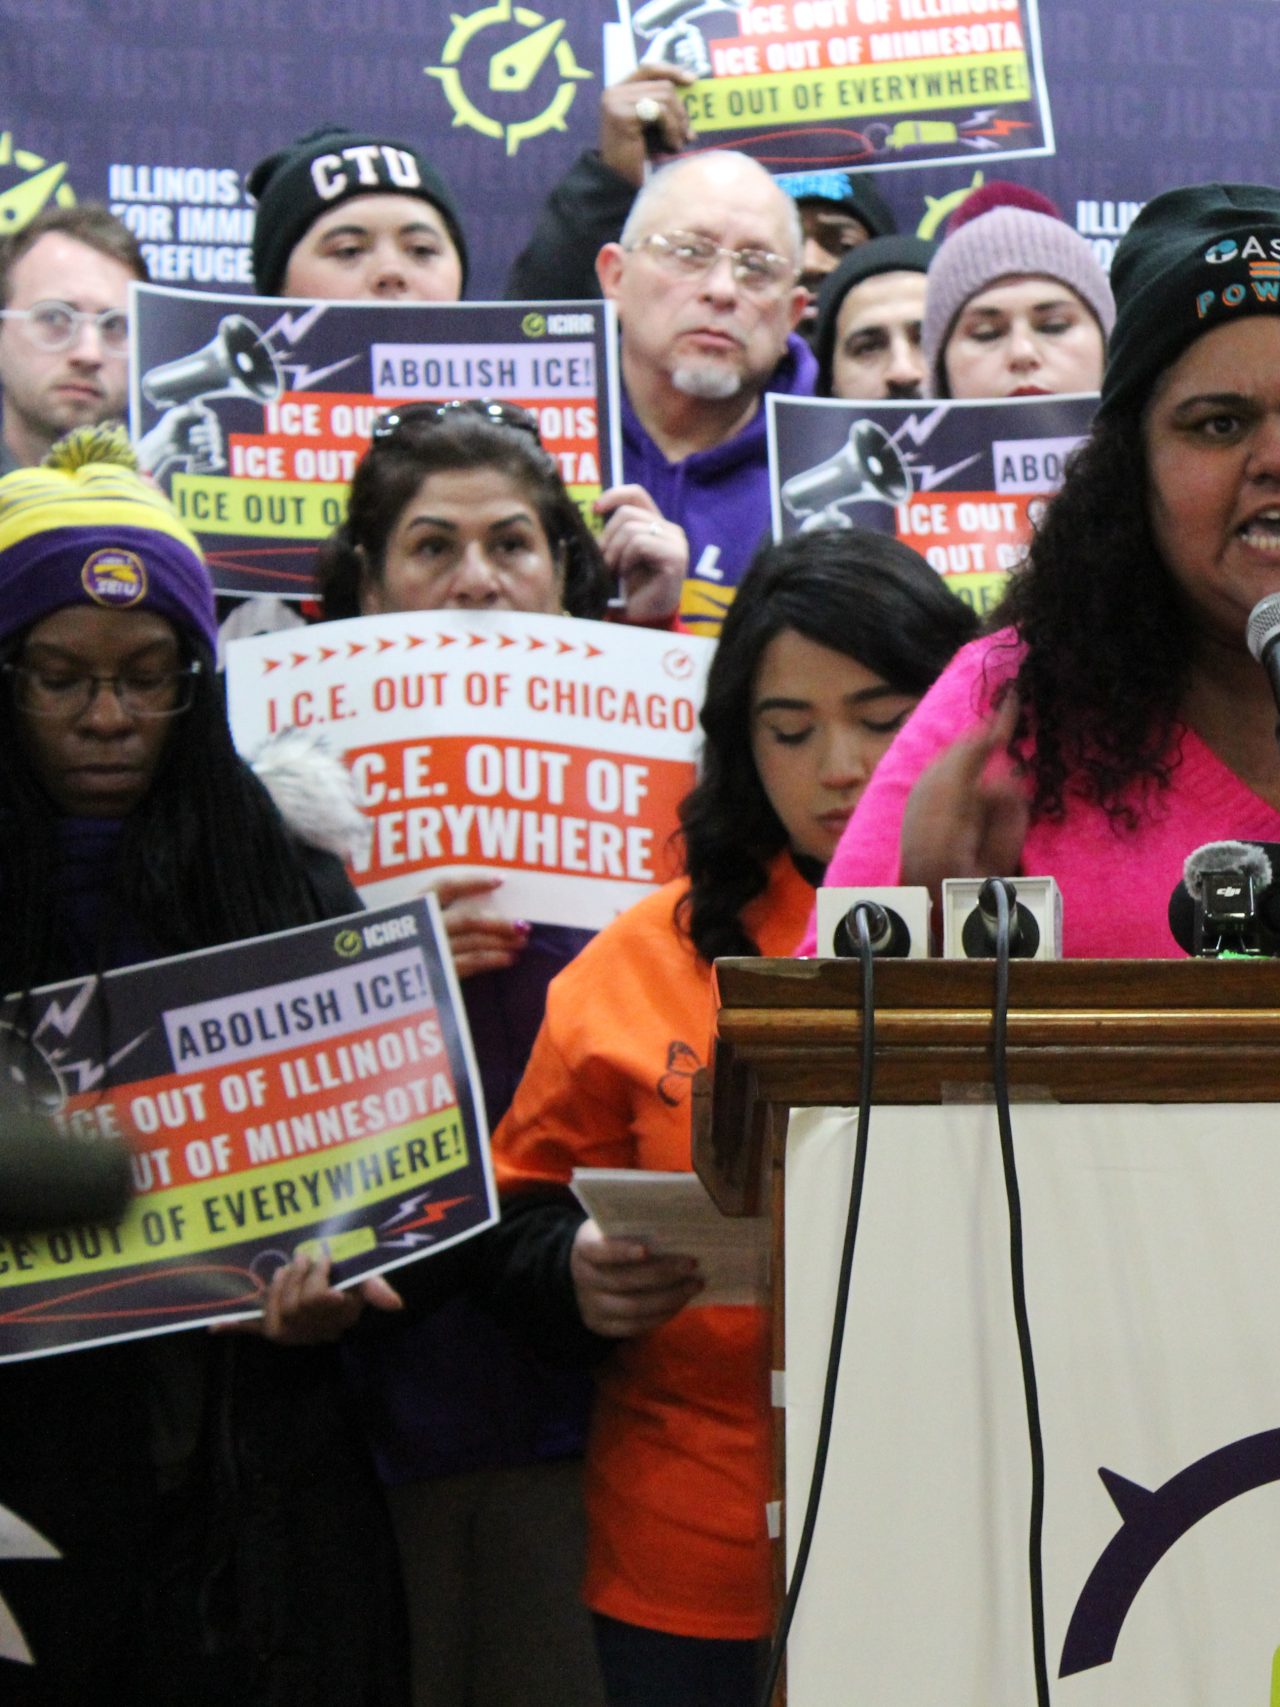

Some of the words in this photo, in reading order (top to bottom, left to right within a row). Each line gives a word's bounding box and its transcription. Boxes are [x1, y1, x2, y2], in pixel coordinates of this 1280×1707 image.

[741, 3, 789, 36] ICE
[714, 46, 761, 78] ICE
[766, 40, 821, 71] OUT
[828, 36, 862, 65] OF
[869, 22, 1024, 62] MINNESOTA
[684, 91, 715, 121] CE
[728, 86, 780, 117] OUT
[793, 81, 825, 111] OF
[838, 63, 1027, 106] EVERYWHERE!
[109, 164, 240, 205] ILLINOIS
[310, 145, 422, 201] CTU
[378, 357, 516, 388] ABOLISH
[531, 357, 595, 388] ICE!
[266, 402, 322, 437] ICE
[230, 445, 285, 479] ICE
[294, 447, 358, 482] OUT
[178, 489, 231, 521] ICE
[244, 494, 307, 526] OUT
[899, 502, 950, 536] ICE
[957, 501, 1018, 534] OUT
[925, 543, 985, 575] OUT
[373, 672, 449, 713] OUT
[465, 672, 511, 708] OF
[527, 676, 696, 733] CHICAGO
[465, 743, 572, 806] OUT
[586, 758, 650, 818] OF
[362, 914, 418, 949] ICIRR
[177, 988, 342, 1062] ABOLISH
[354, 963, 428, 1016] ICE!
[131, 1082, 207, 1134] OUT
[220, 1068, 268, 1114] OF
[279, 1019, 444, 1099] ILLINOIS
[131, 1147, 172, 1192] UT
[185, 1134, 233, 1179] OF
[245, 1072, 456, 1165] MINNESOTA
[142, 1204, 186, 1246] OF
[203, 1123, 463, 1235] EVERYWHERE!
